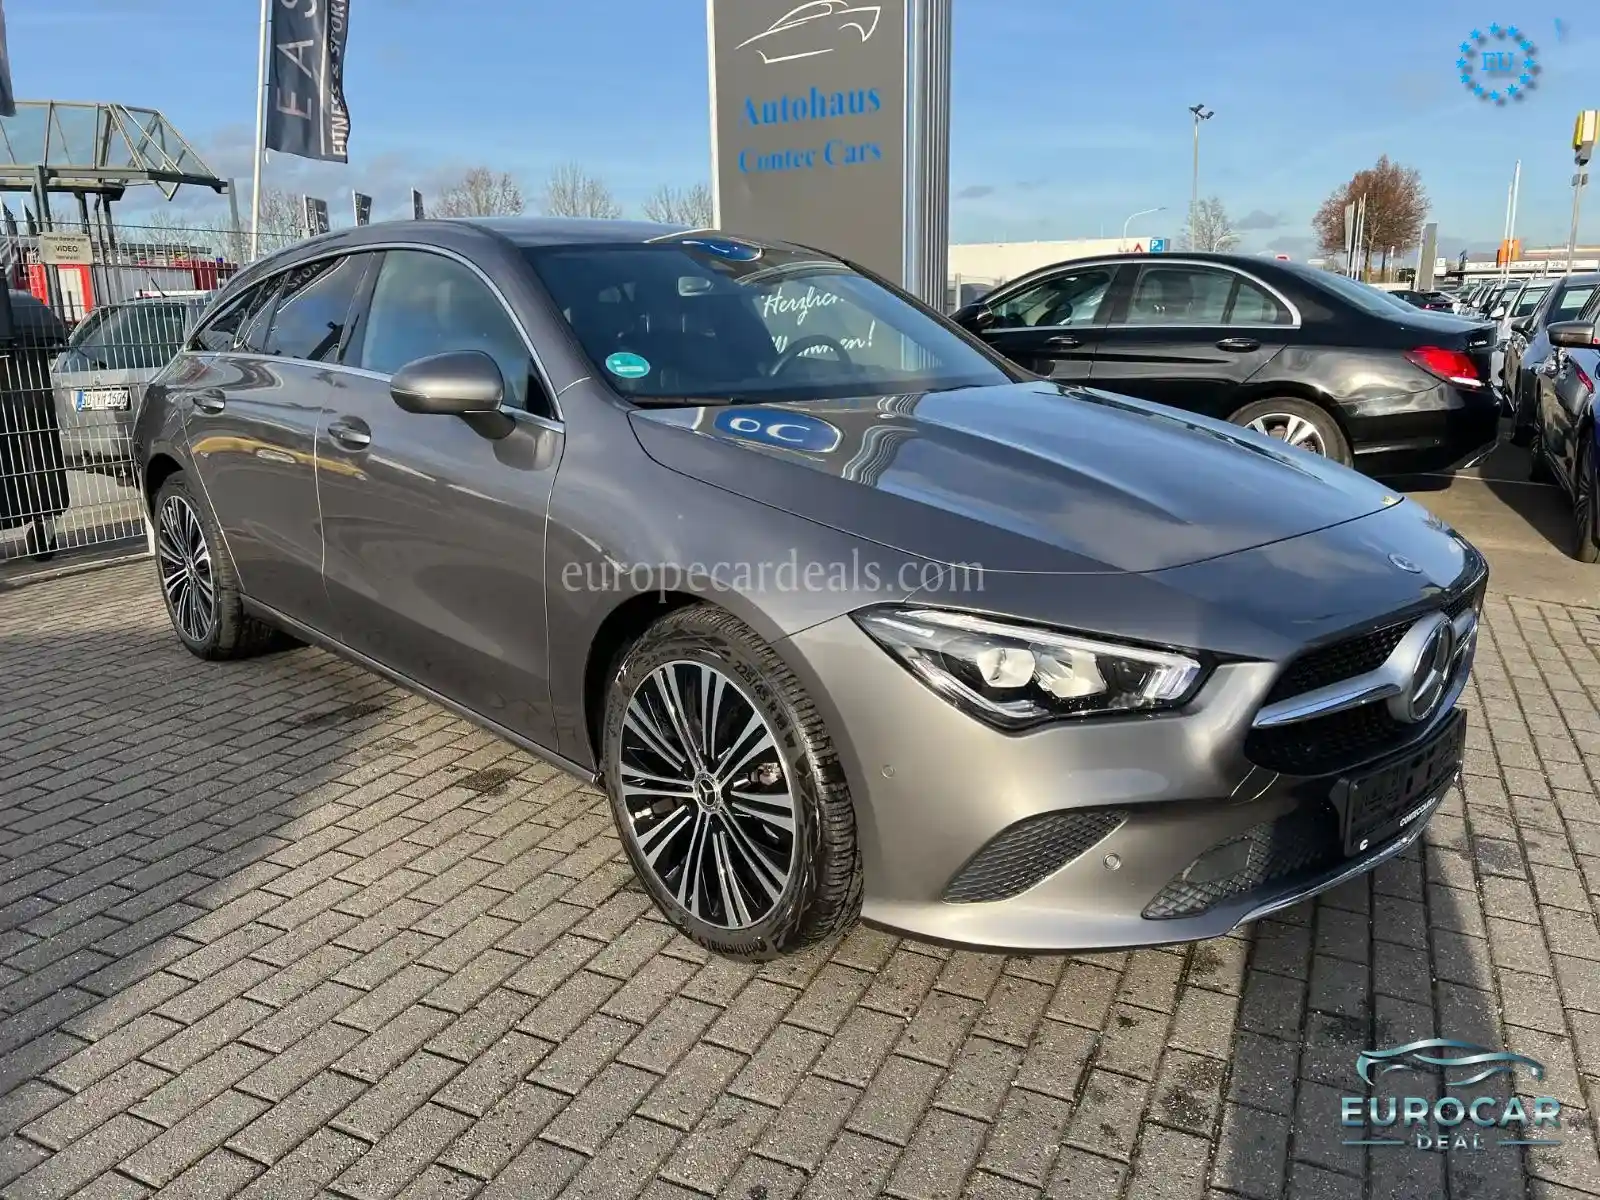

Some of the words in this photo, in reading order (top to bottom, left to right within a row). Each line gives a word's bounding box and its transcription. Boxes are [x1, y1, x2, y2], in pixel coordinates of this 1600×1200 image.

[330, 0, 345, 57] SPOR
[331, 64, 340, 76] &
[331, 83, 349, 156] FITNESS
[739, 86, 881, 128] Autohaus
[824, 139, 882, 166] Cars
